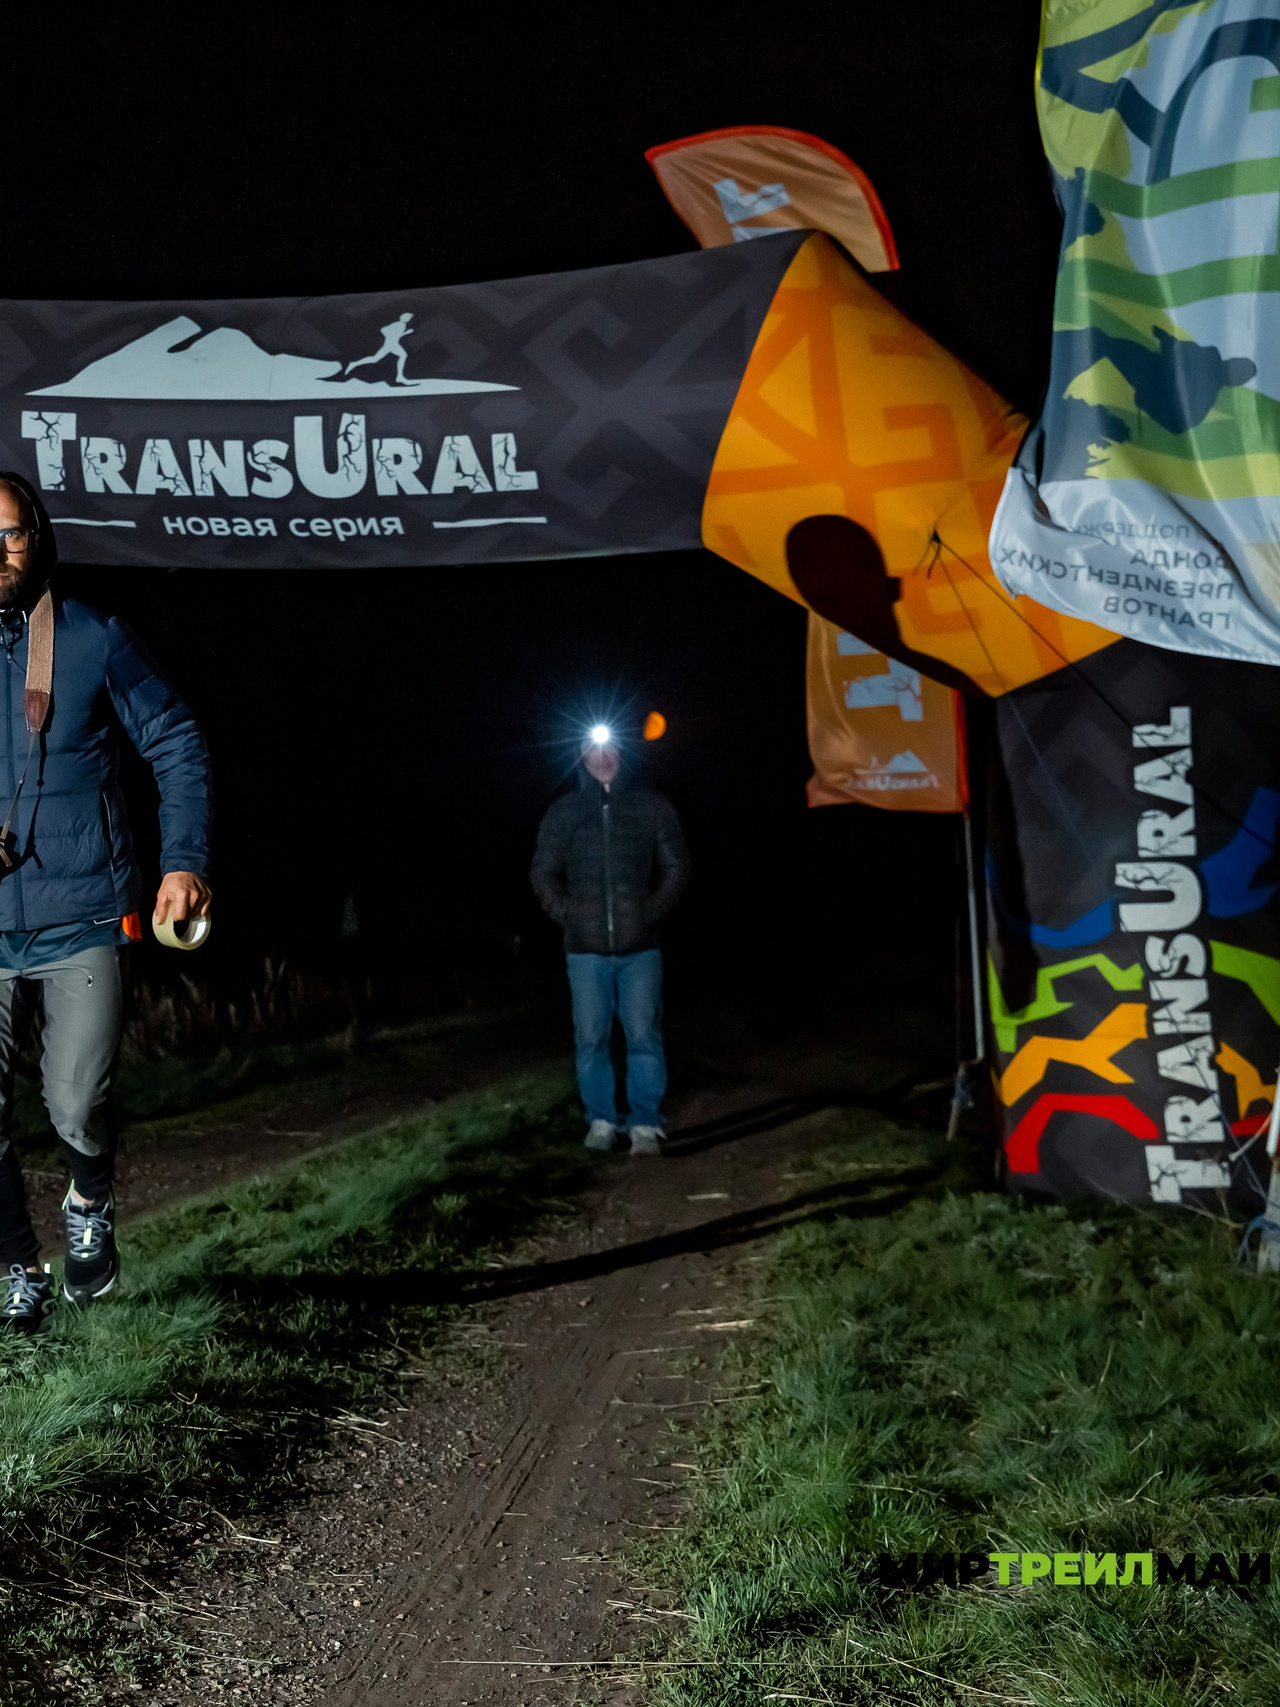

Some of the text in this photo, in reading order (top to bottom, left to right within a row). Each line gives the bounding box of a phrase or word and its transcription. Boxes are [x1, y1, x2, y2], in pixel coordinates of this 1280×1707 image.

[21, 411, 539, 499] TRANSURAL
[162, 515, 406, 543] новая серия
[1114, 706, 1232, 1203] TRANSURAL
